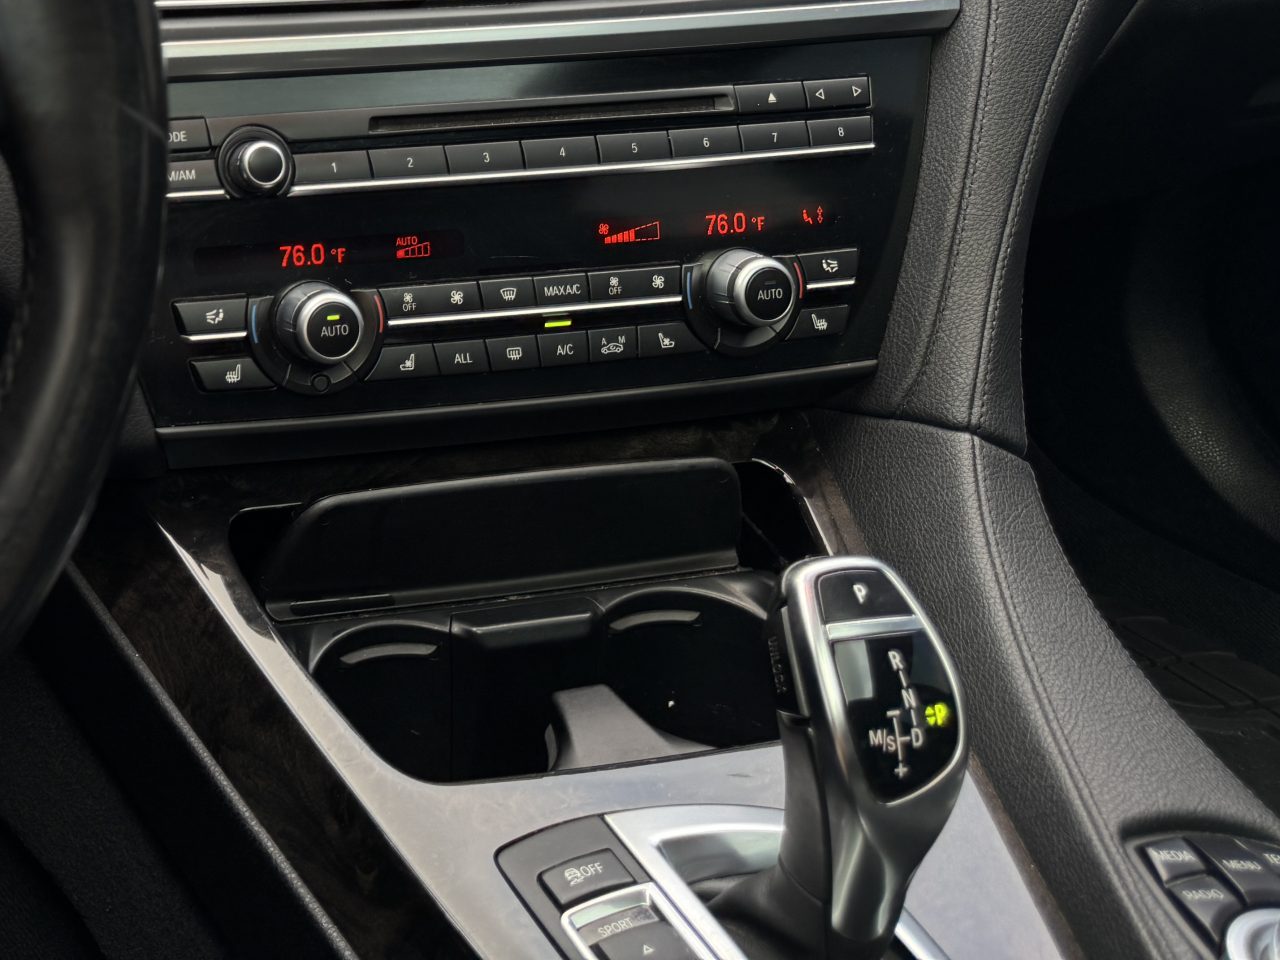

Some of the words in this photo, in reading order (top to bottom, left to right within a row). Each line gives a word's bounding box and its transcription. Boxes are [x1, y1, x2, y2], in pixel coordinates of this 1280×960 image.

[772, 132, 778, 142] 7
[838, 127, 845, 137] 8
[632, 143, 638, 153] 5
[703, 138, 710, 148] 6
[483, 152, 490, 163] 3
[559, 147, 566, 157] 4
[332, 162, 337, 172] 1
[407, 158, 414, 168] 2
[706, 212, 746, 235] 76.0
[396, 236, 417, 246] AUTO
[280, 244, 324, 268] 76.0
[609, 287, 622, 295] OFF
[758, 288, 783, 300] AUTO
[403, 303, 416, 311] OFF
[321, 324, 349, 337] AUTO
[557, 344, 574, 355] A/C
[454, 353, 473, 364] ALL
[853, 584, 867, 604] P
[888, 651, 904, 671] R
[902, 688, 916, 709] N
[911, 728, 923, 748] D
[1152, 850, 1197, 861] MEDIA
[580, 862, 604, 877] OFF
[1222, 859, 1262, 871] MENU
[1182, 889, 1224, 900] RADIO
[597, 918, 633, 936] SPORT
